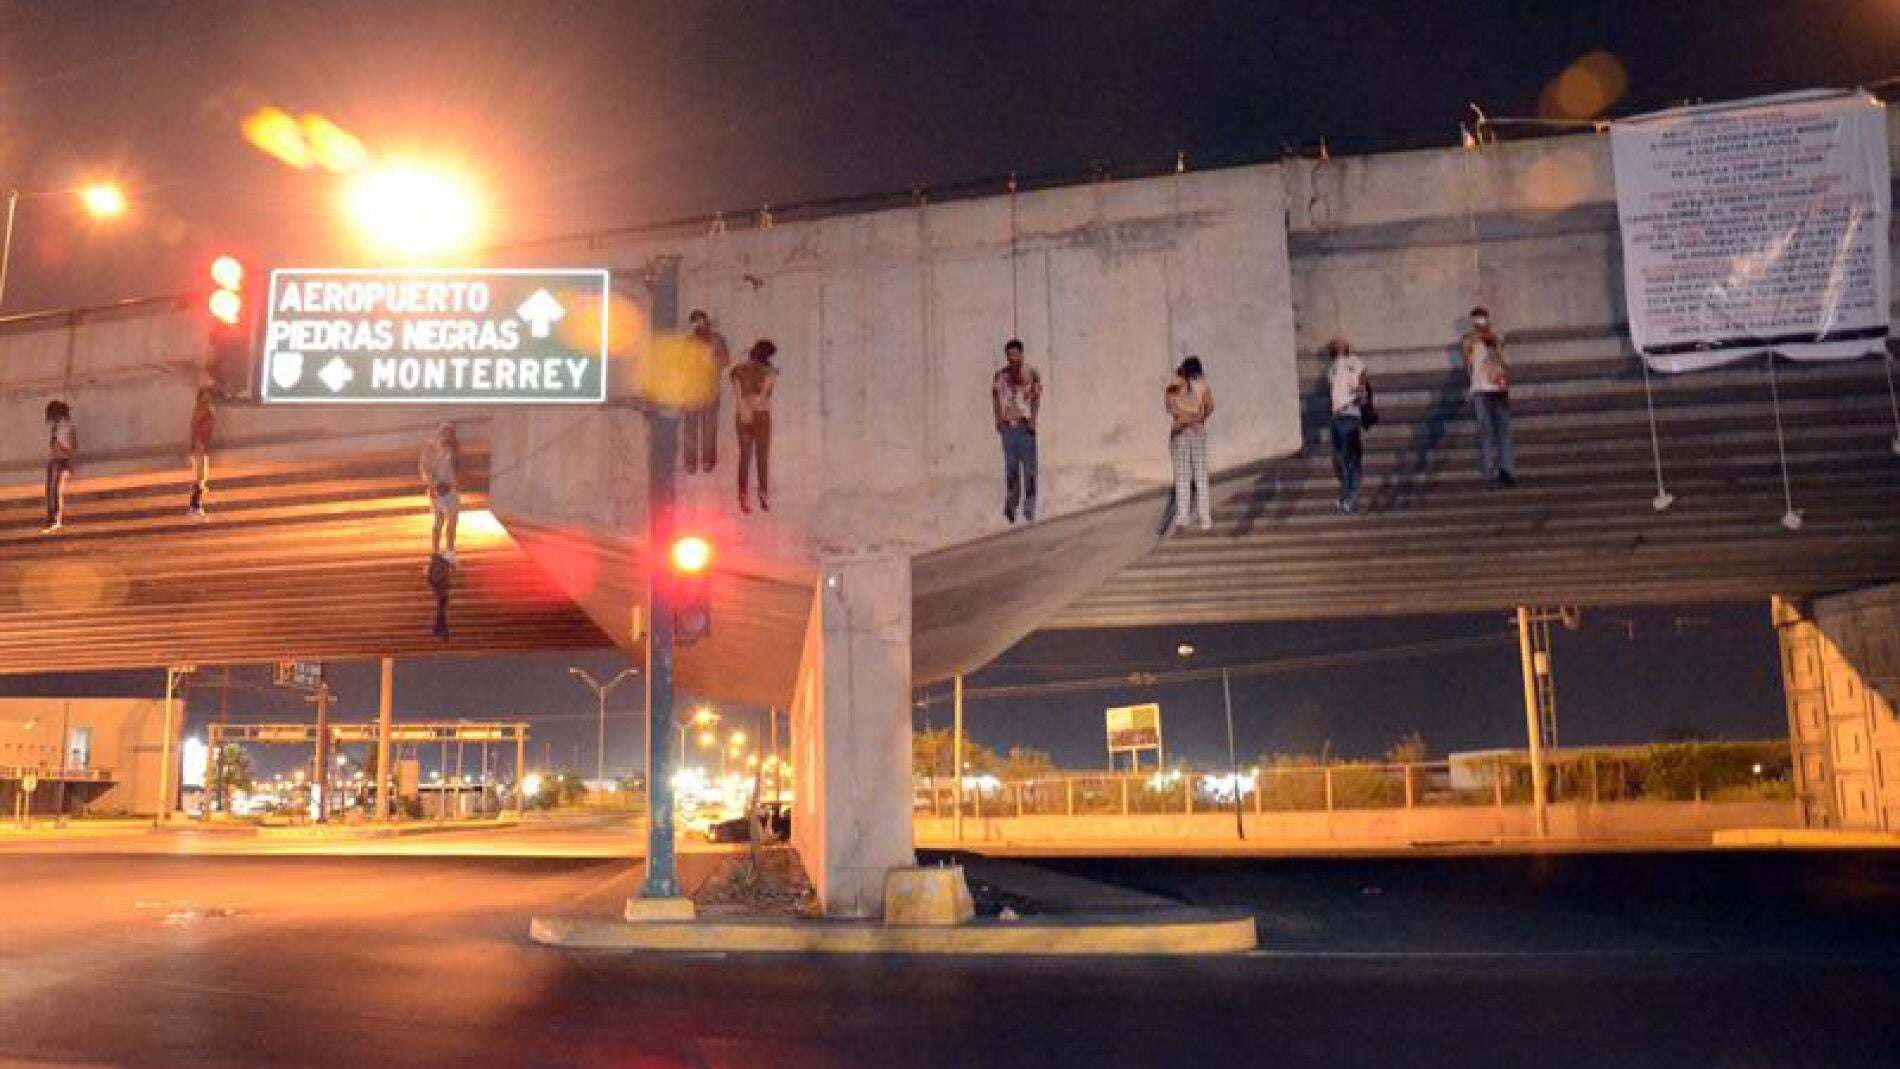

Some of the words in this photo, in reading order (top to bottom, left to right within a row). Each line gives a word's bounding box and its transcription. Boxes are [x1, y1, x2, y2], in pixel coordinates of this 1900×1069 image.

[279, 281, 489, 312] AEROPUERTO
[269, 320, 393, 350] PIEDRAS
[402, 320, 519, 350] NEGRAS
[371, 358, 589, 388] MONTERREY
